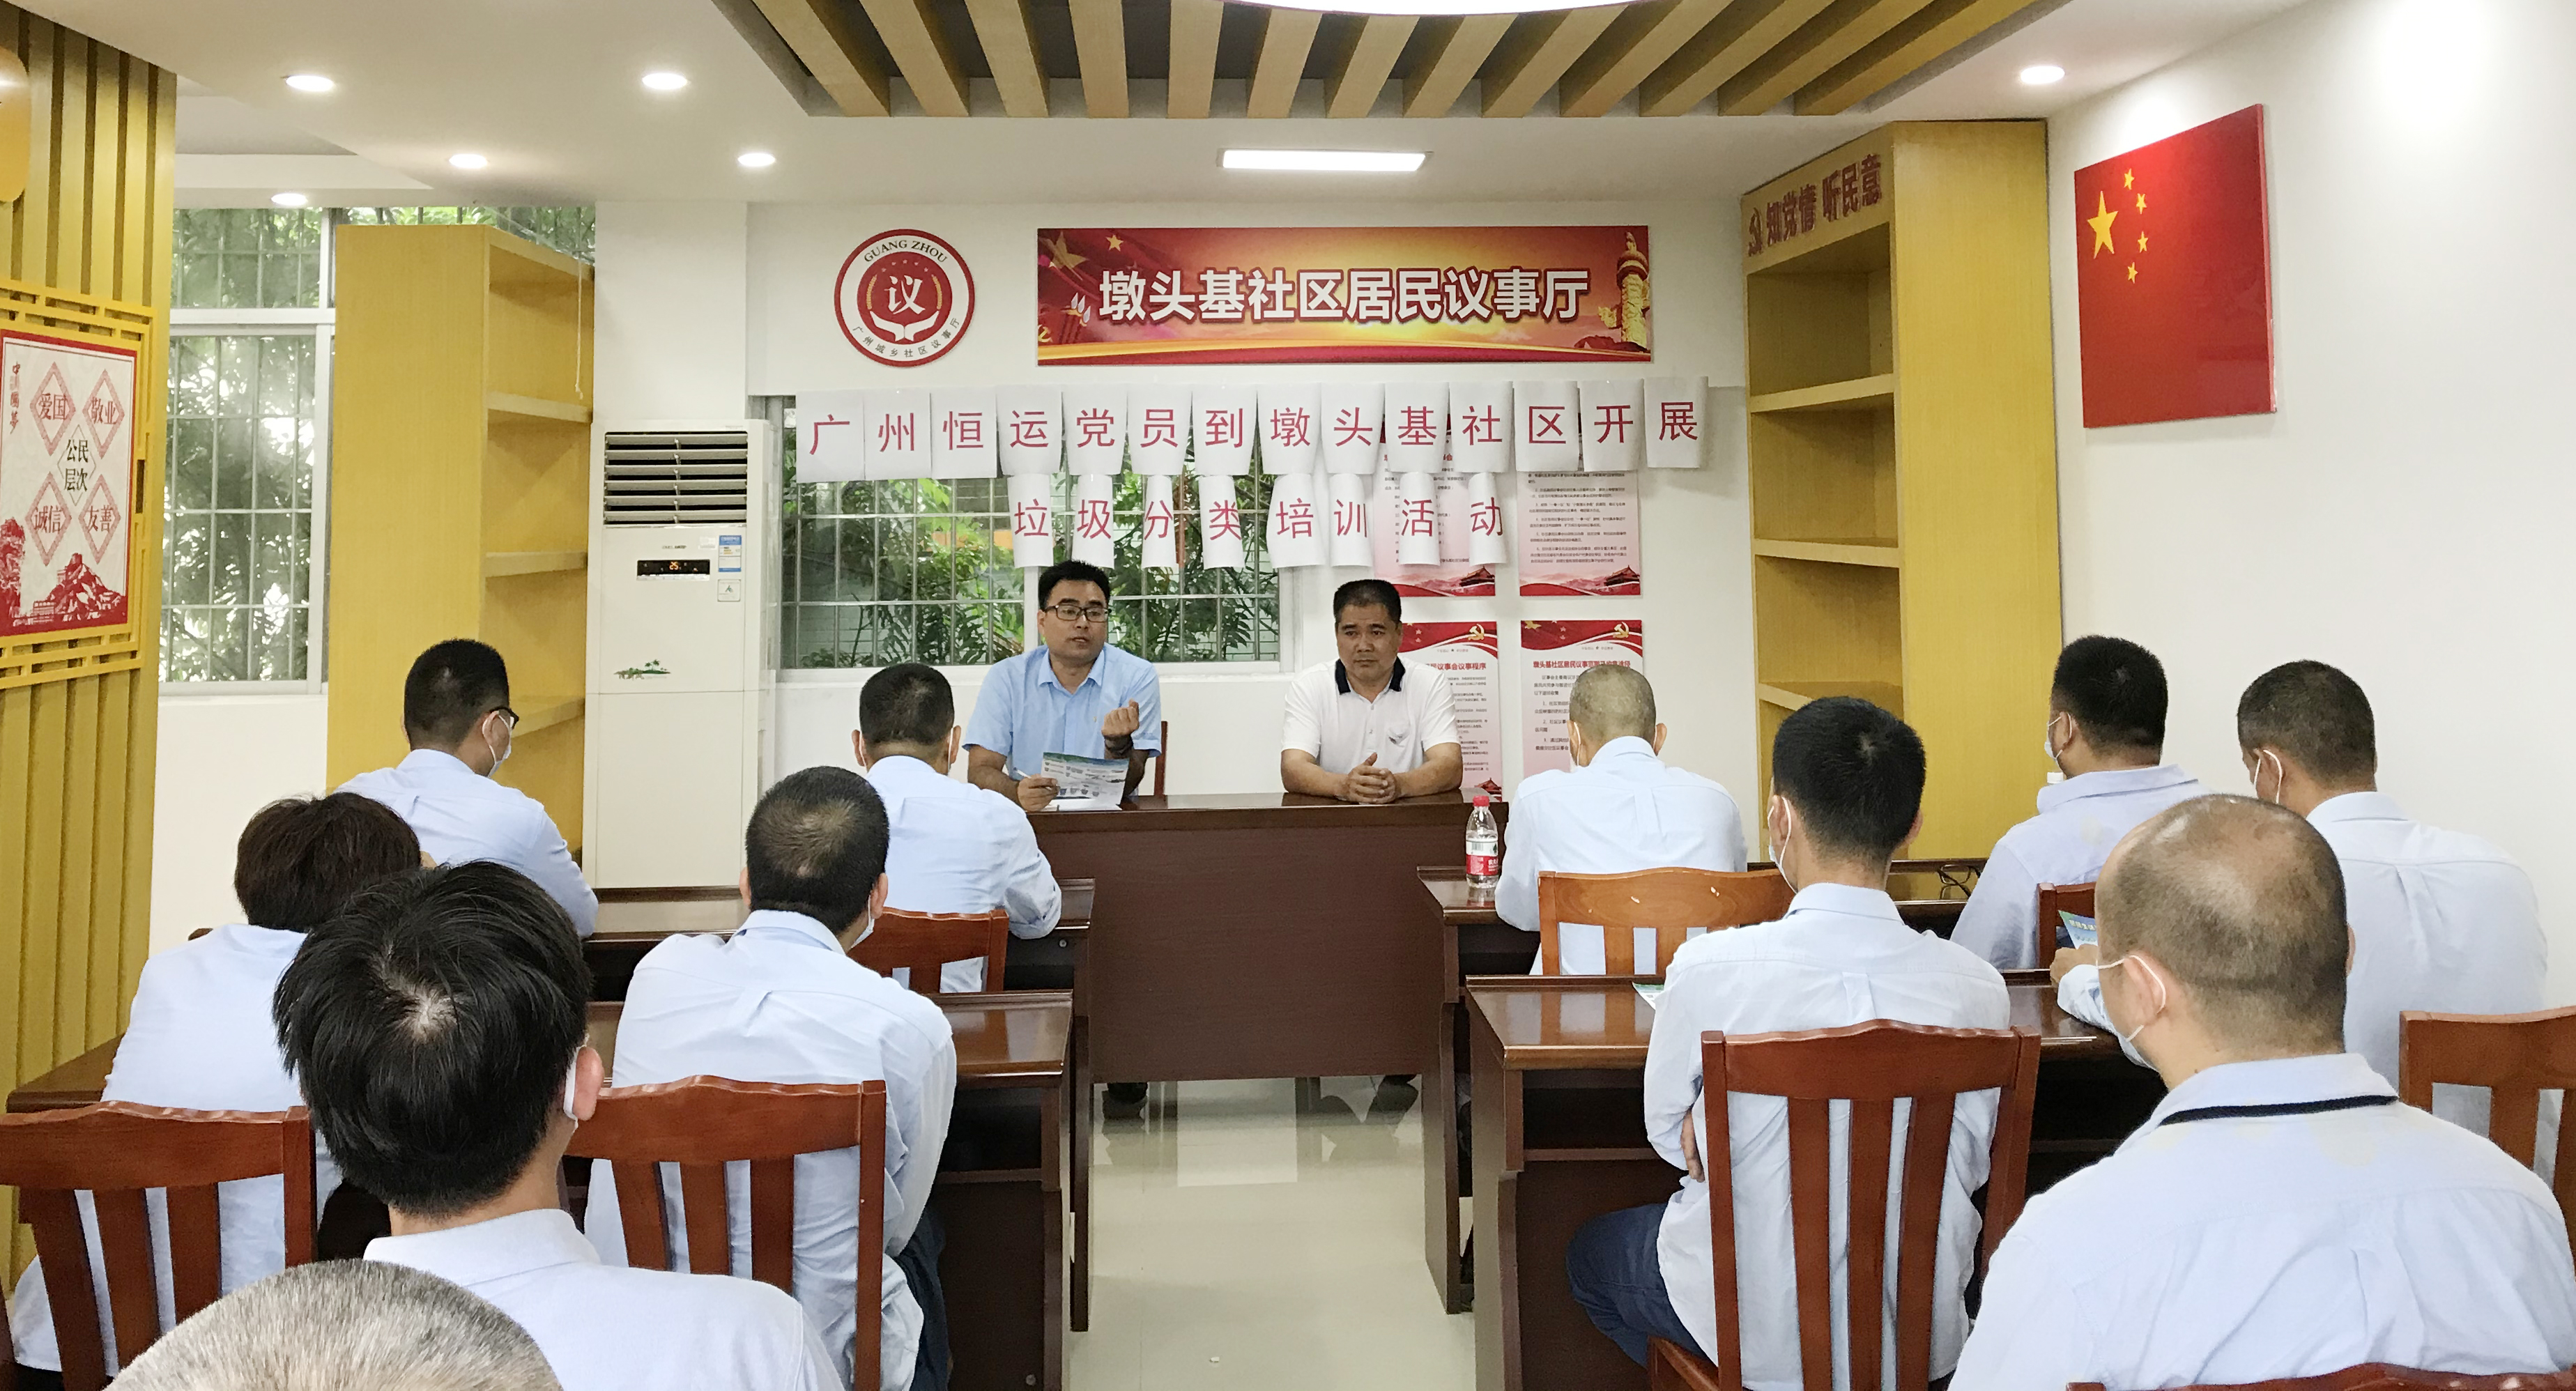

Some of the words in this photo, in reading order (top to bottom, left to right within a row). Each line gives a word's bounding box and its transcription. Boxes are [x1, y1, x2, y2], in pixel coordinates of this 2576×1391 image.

[1822, 153, 1882, 223] 听民意
[864, 240, 907, 263] GUANG
[911, 240, 948, 263] ZHOU
[884, 275, 926, 314] 议
[1099, 268, 1590, 321] 墩头基社区居民议事厅
[852, 317, 960, 358] 广州城乡社区议事厅
[38, 392, 68, 420] 爱国
[91, 397, 117, 425] 敬业
[808, 401, 1699, 456] 广州恒运党员到墩头基社区开展
[66, 439, 89, 463] 公民
[64, 468, 88, 492] 层次
[33, 505, 63, 534] 诚信
[86, 505, 114, 532] 友善
[1013, 495, 1503, 541] 垃圾分类培训活动
